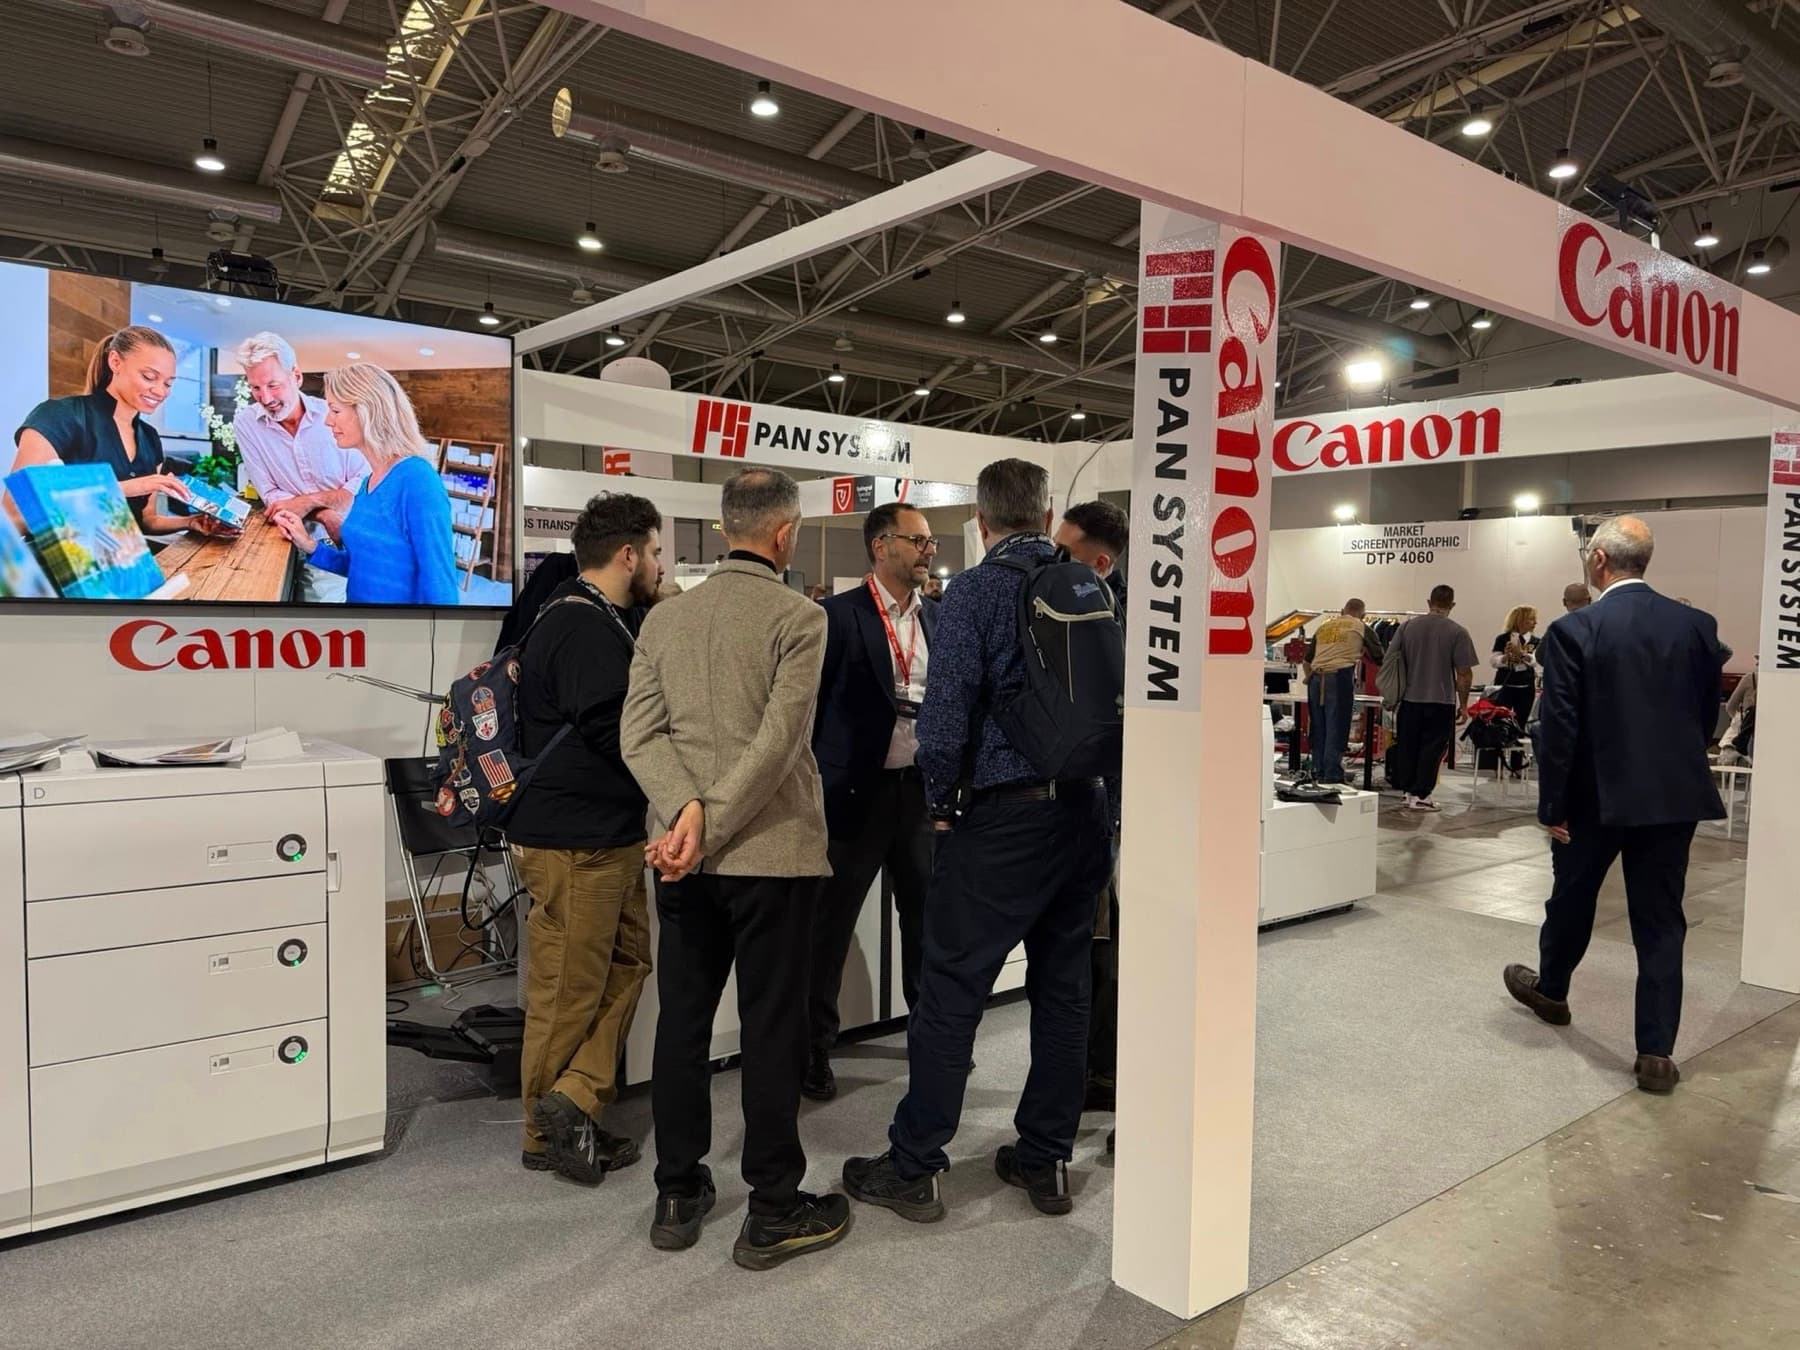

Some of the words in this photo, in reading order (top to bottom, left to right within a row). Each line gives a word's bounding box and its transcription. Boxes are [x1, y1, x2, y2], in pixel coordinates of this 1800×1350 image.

[1559, 222, 1740, 377] Canon
[754, 421, 811, 452] PAN
[816, 430, 911, 464] SYSM
[1154, 367, 1191, 481] PAN
[1208, 236, 1277, 655] Canon
[1273, 406, 1501, 472] Canon
[1351, 536, 1460, 550] SCREENTYPOGRAPHIC
[1366, 552, 1396, 565] DTP
[1400, 551, 1434, 564] 4060
[1384, 525, 1425, 537] MARKET
[1147, 493, 1184, 702] SYSTEM
[1776, 558, 1800, 669] SYSTEM
[109, 619, 366, 671] Canon
[33, 787, 46, 800] D
